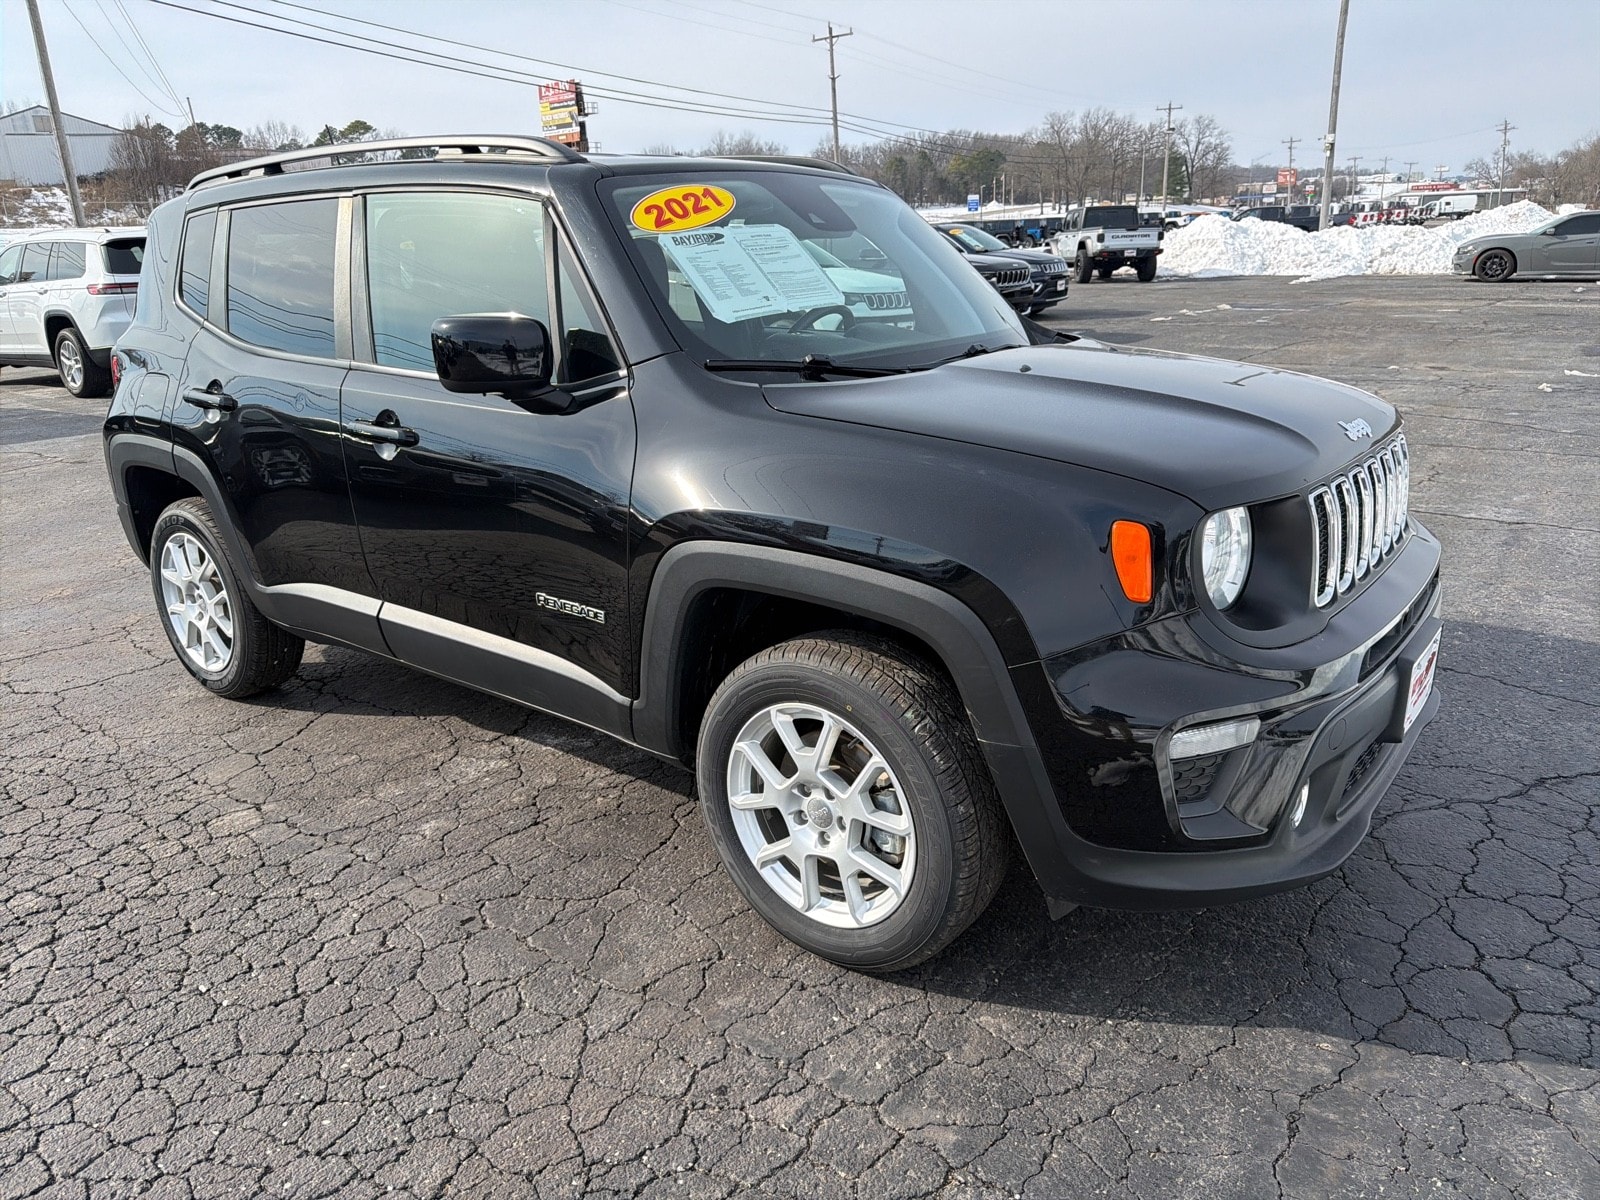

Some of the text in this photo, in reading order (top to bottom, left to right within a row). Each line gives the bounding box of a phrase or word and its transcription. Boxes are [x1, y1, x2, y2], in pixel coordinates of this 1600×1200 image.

[644, 188, 724, 229] 2021
[672, 233, 710, 246] BAYIRD
[536, 592, 605, 624] RENEGADE
